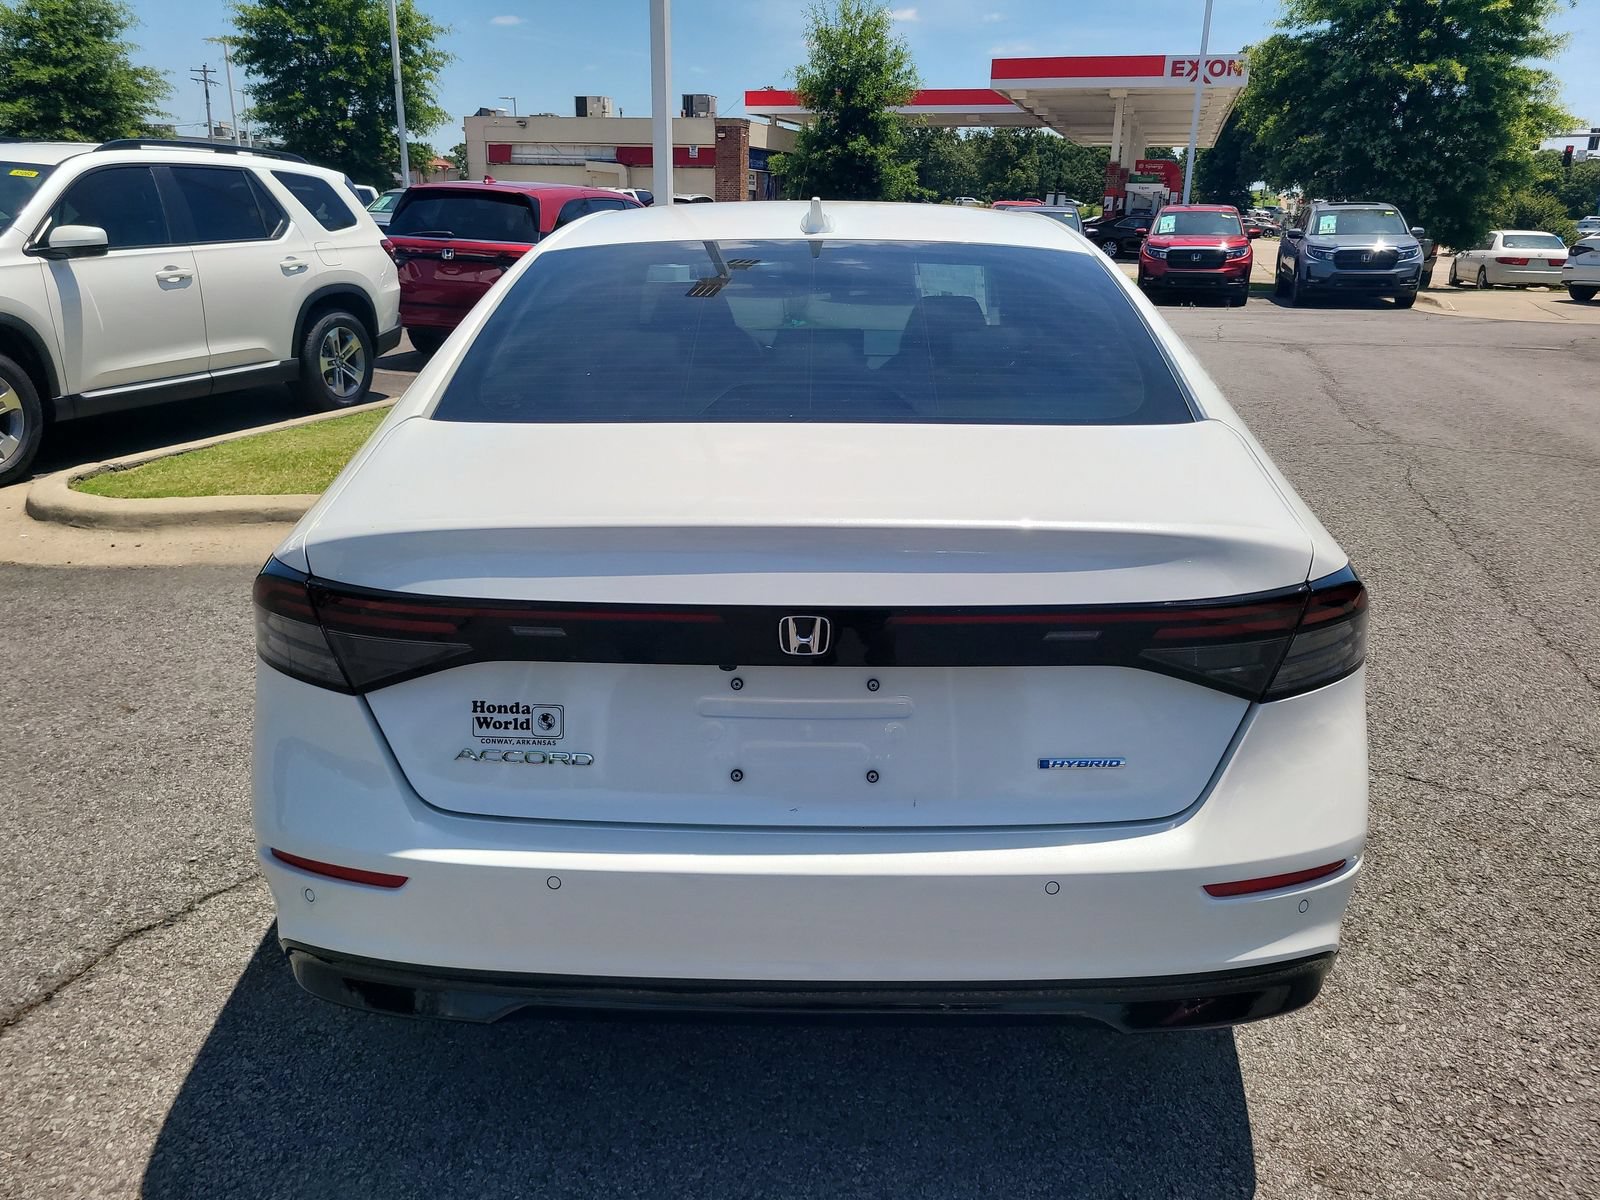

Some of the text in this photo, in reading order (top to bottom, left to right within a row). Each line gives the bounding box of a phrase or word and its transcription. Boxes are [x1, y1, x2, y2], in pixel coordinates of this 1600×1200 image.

[1171, 59, 1243, 84] EXXON
[471, 700, 531, 715] Honda
[475, 716, 531, 731] World
[480, 738, 515, 746] CONWAY,
[454, 748, 595, 766] ACCORD
[1051, 759, 1121, 768] HYBRID
